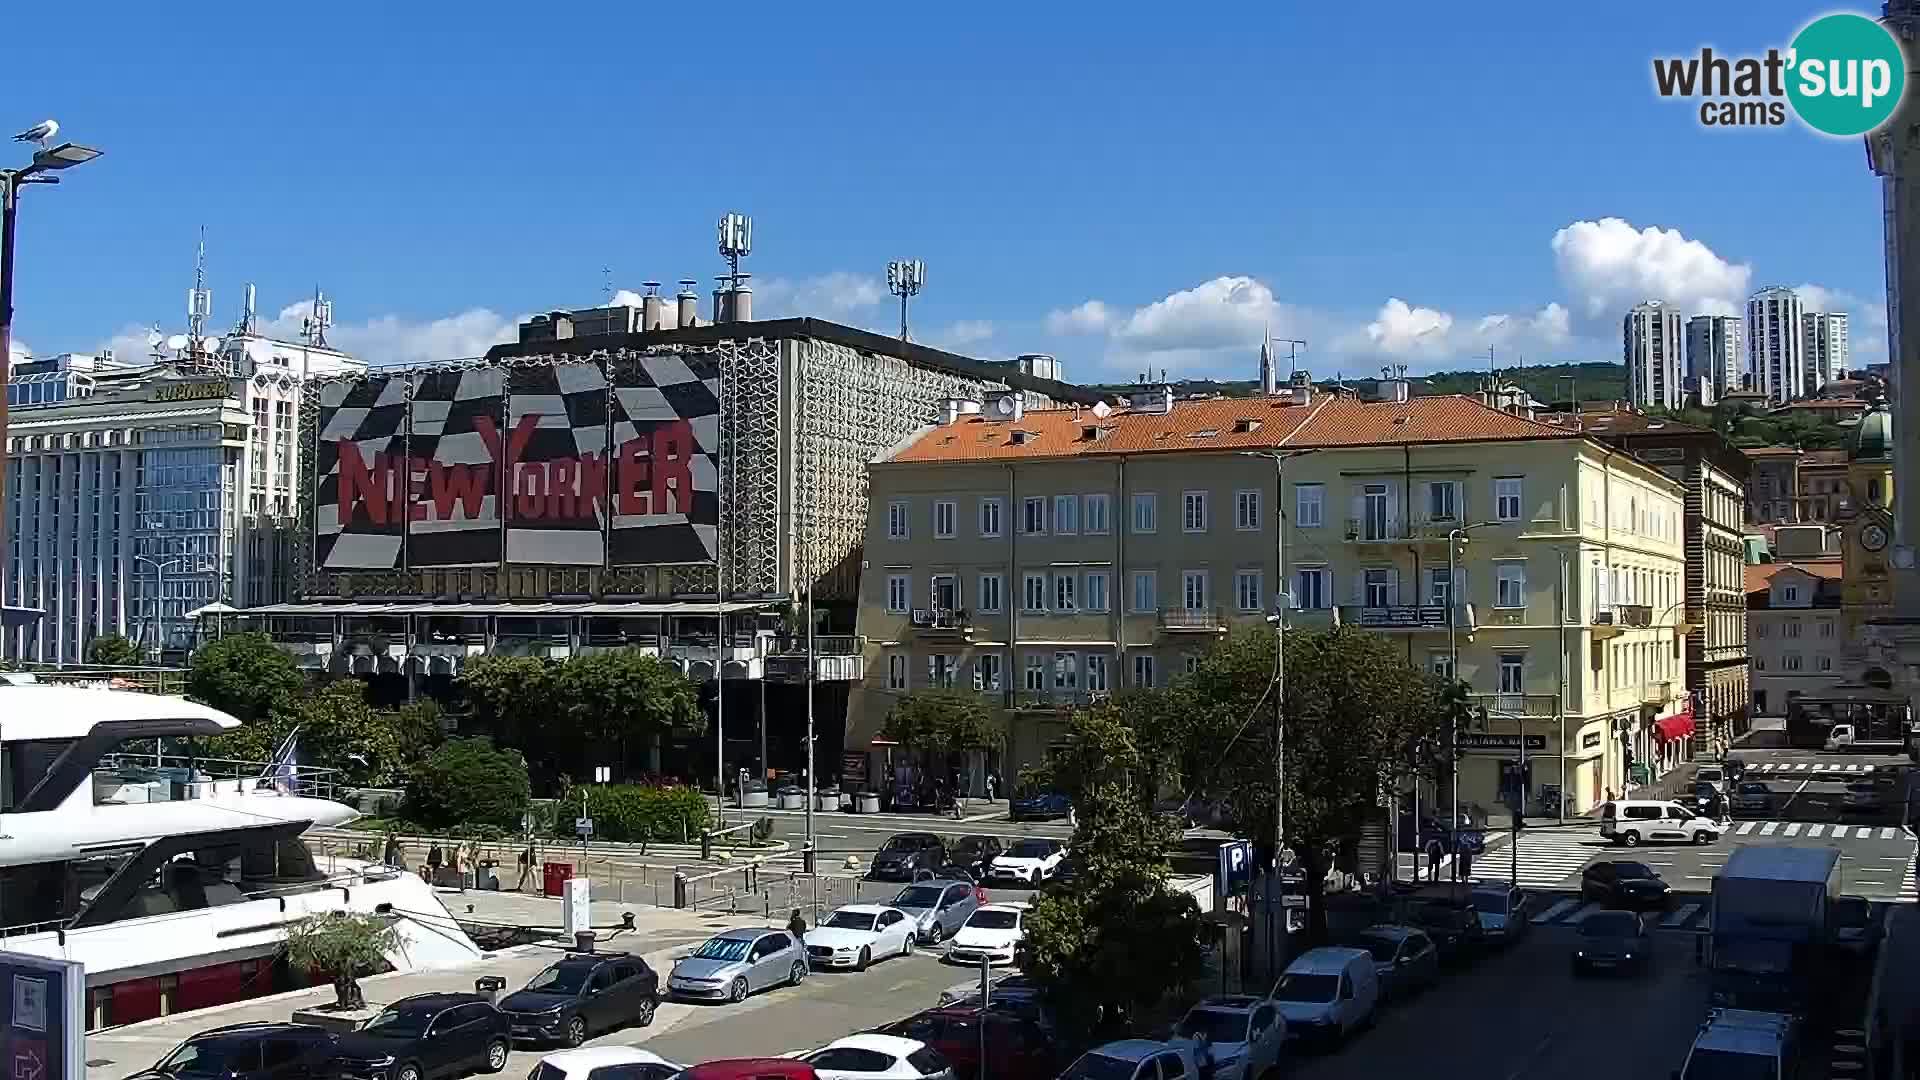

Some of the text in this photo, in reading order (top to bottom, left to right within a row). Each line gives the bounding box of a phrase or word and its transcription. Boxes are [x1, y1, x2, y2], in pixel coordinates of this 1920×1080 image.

[337, 414, 694, 527] NEW YORKER
[1231, 847, 1244, 872] P
